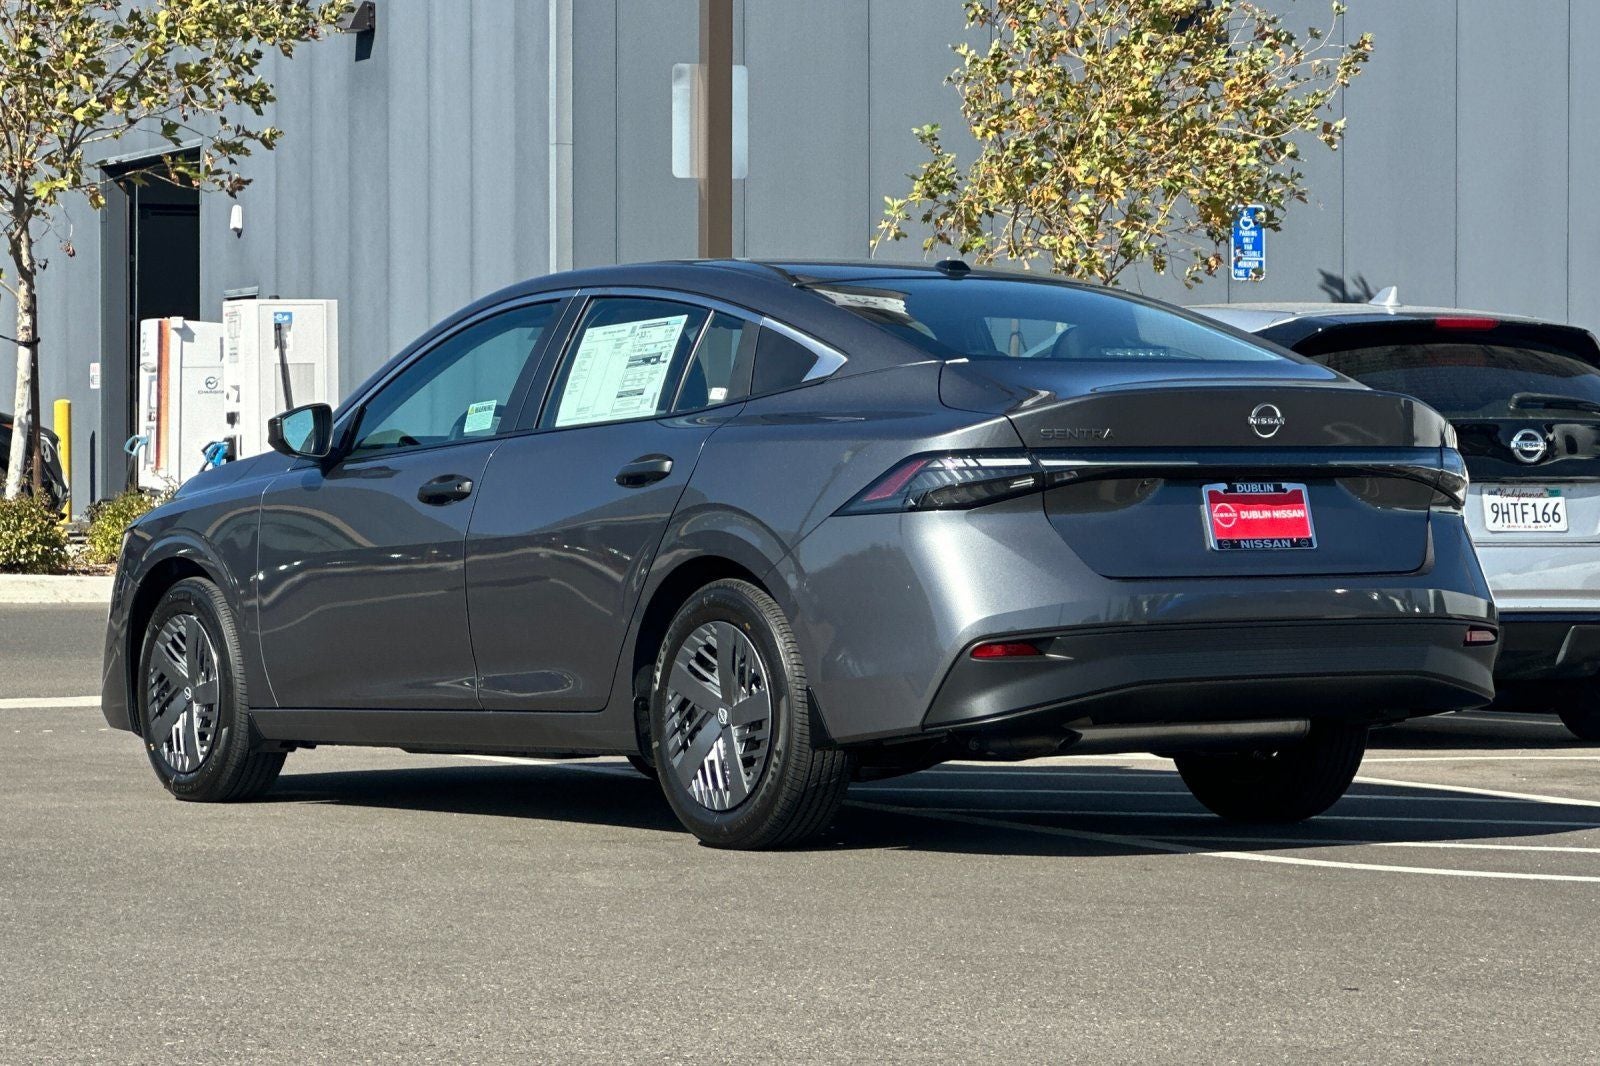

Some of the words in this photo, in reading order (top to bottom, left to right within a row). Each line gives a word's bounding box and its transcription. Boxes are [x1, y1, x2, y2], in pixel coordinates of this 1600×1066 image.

[1248, 417, 1285, 425] NISSAN
[1040, 428, 1114, 440] SENTRA
[1236, 484, 1274, 493] DUBLIN
[1240, 510, 1272, 520] DUBLIN
[1272, 509, 1305, 519] NISSAN
[1490, 502, 1562, 524] 9HTF166
[1241, 539, 1291, 549] NISSAN
